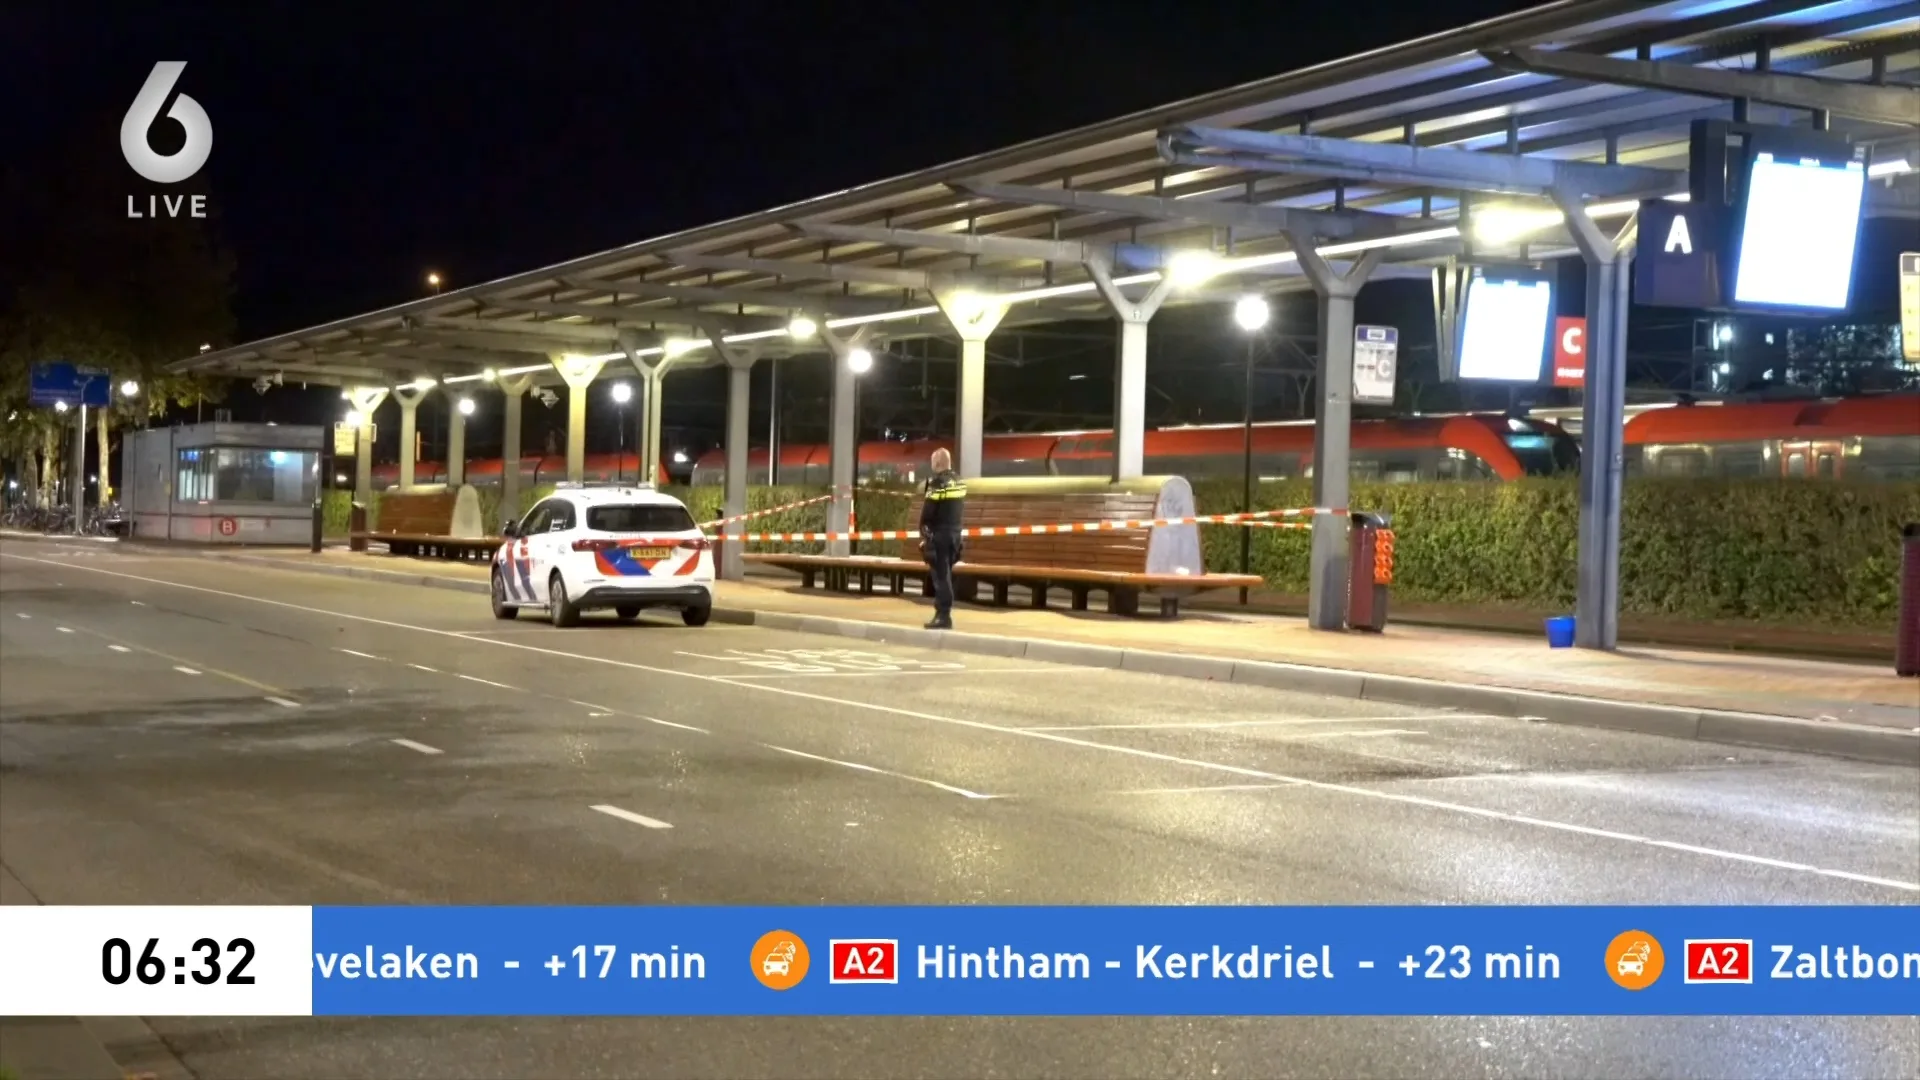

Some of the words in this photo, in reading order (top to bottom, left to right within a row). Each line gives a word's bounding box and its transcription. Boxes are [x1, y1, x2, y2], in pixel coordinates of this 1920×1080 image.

[1664, 214, 1693, 254] A
[1562, 326, 1582, 355] C
[1378, 359, 1391, 378] C
